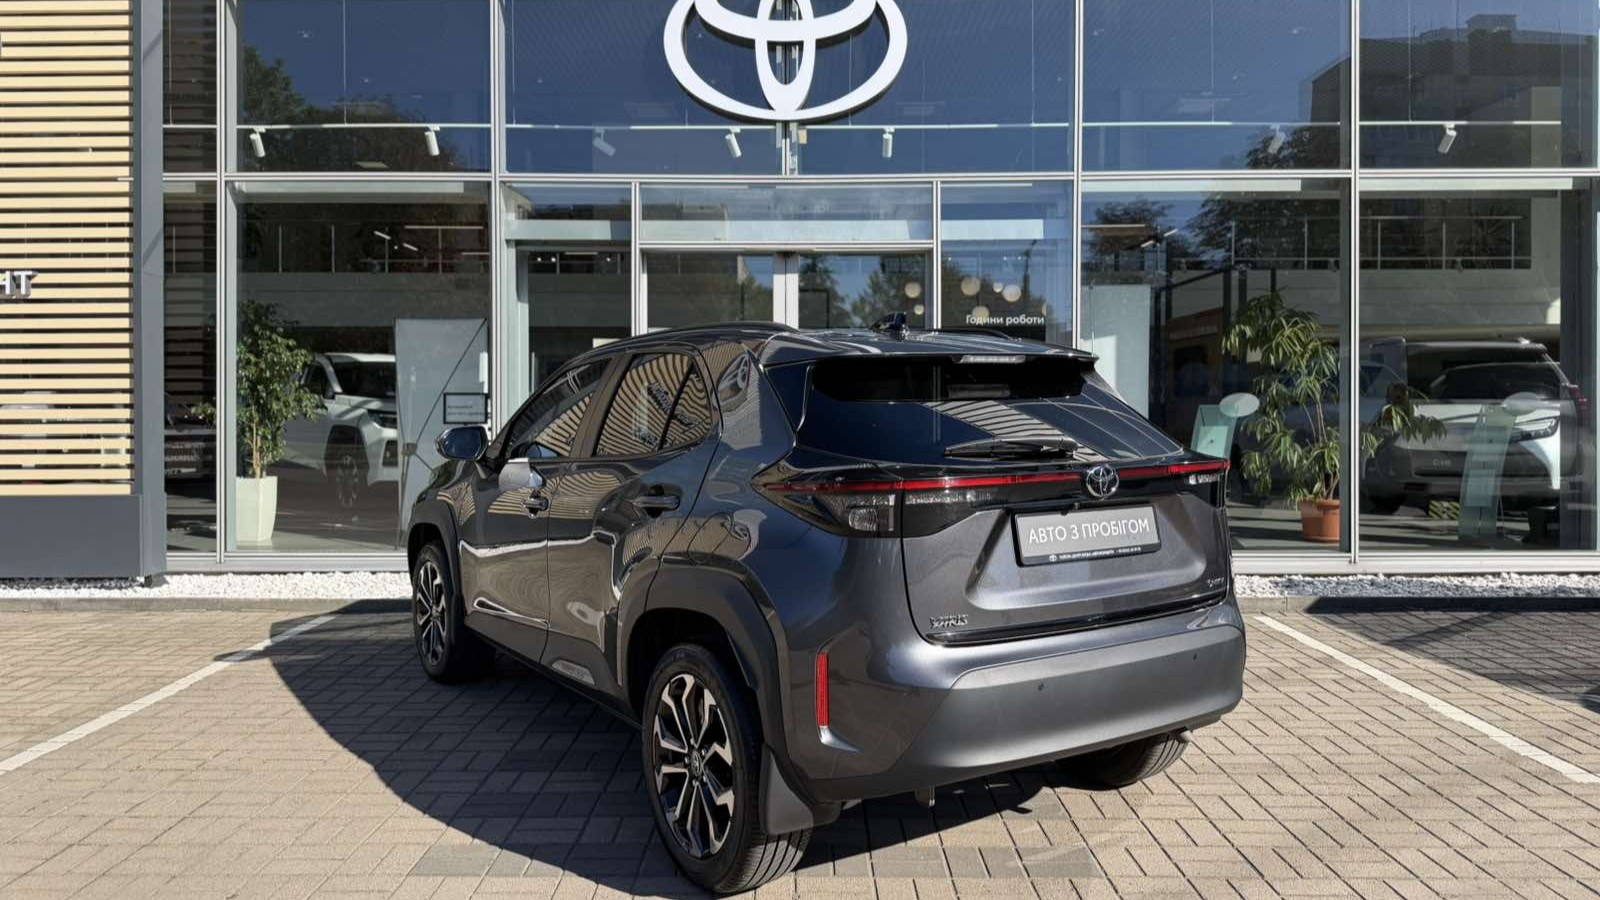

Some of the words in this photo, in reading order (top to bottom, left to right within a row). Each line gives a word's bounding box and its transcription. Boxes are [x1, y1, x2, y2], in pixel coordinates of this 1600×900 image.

[966, 315, 1003, 325] Години
[1005, 314, 1044, 326] роботи
[1028, 525, 1067, 544] АВТО
[1081, 517, 1150, 539] ПРОБІГОМ
